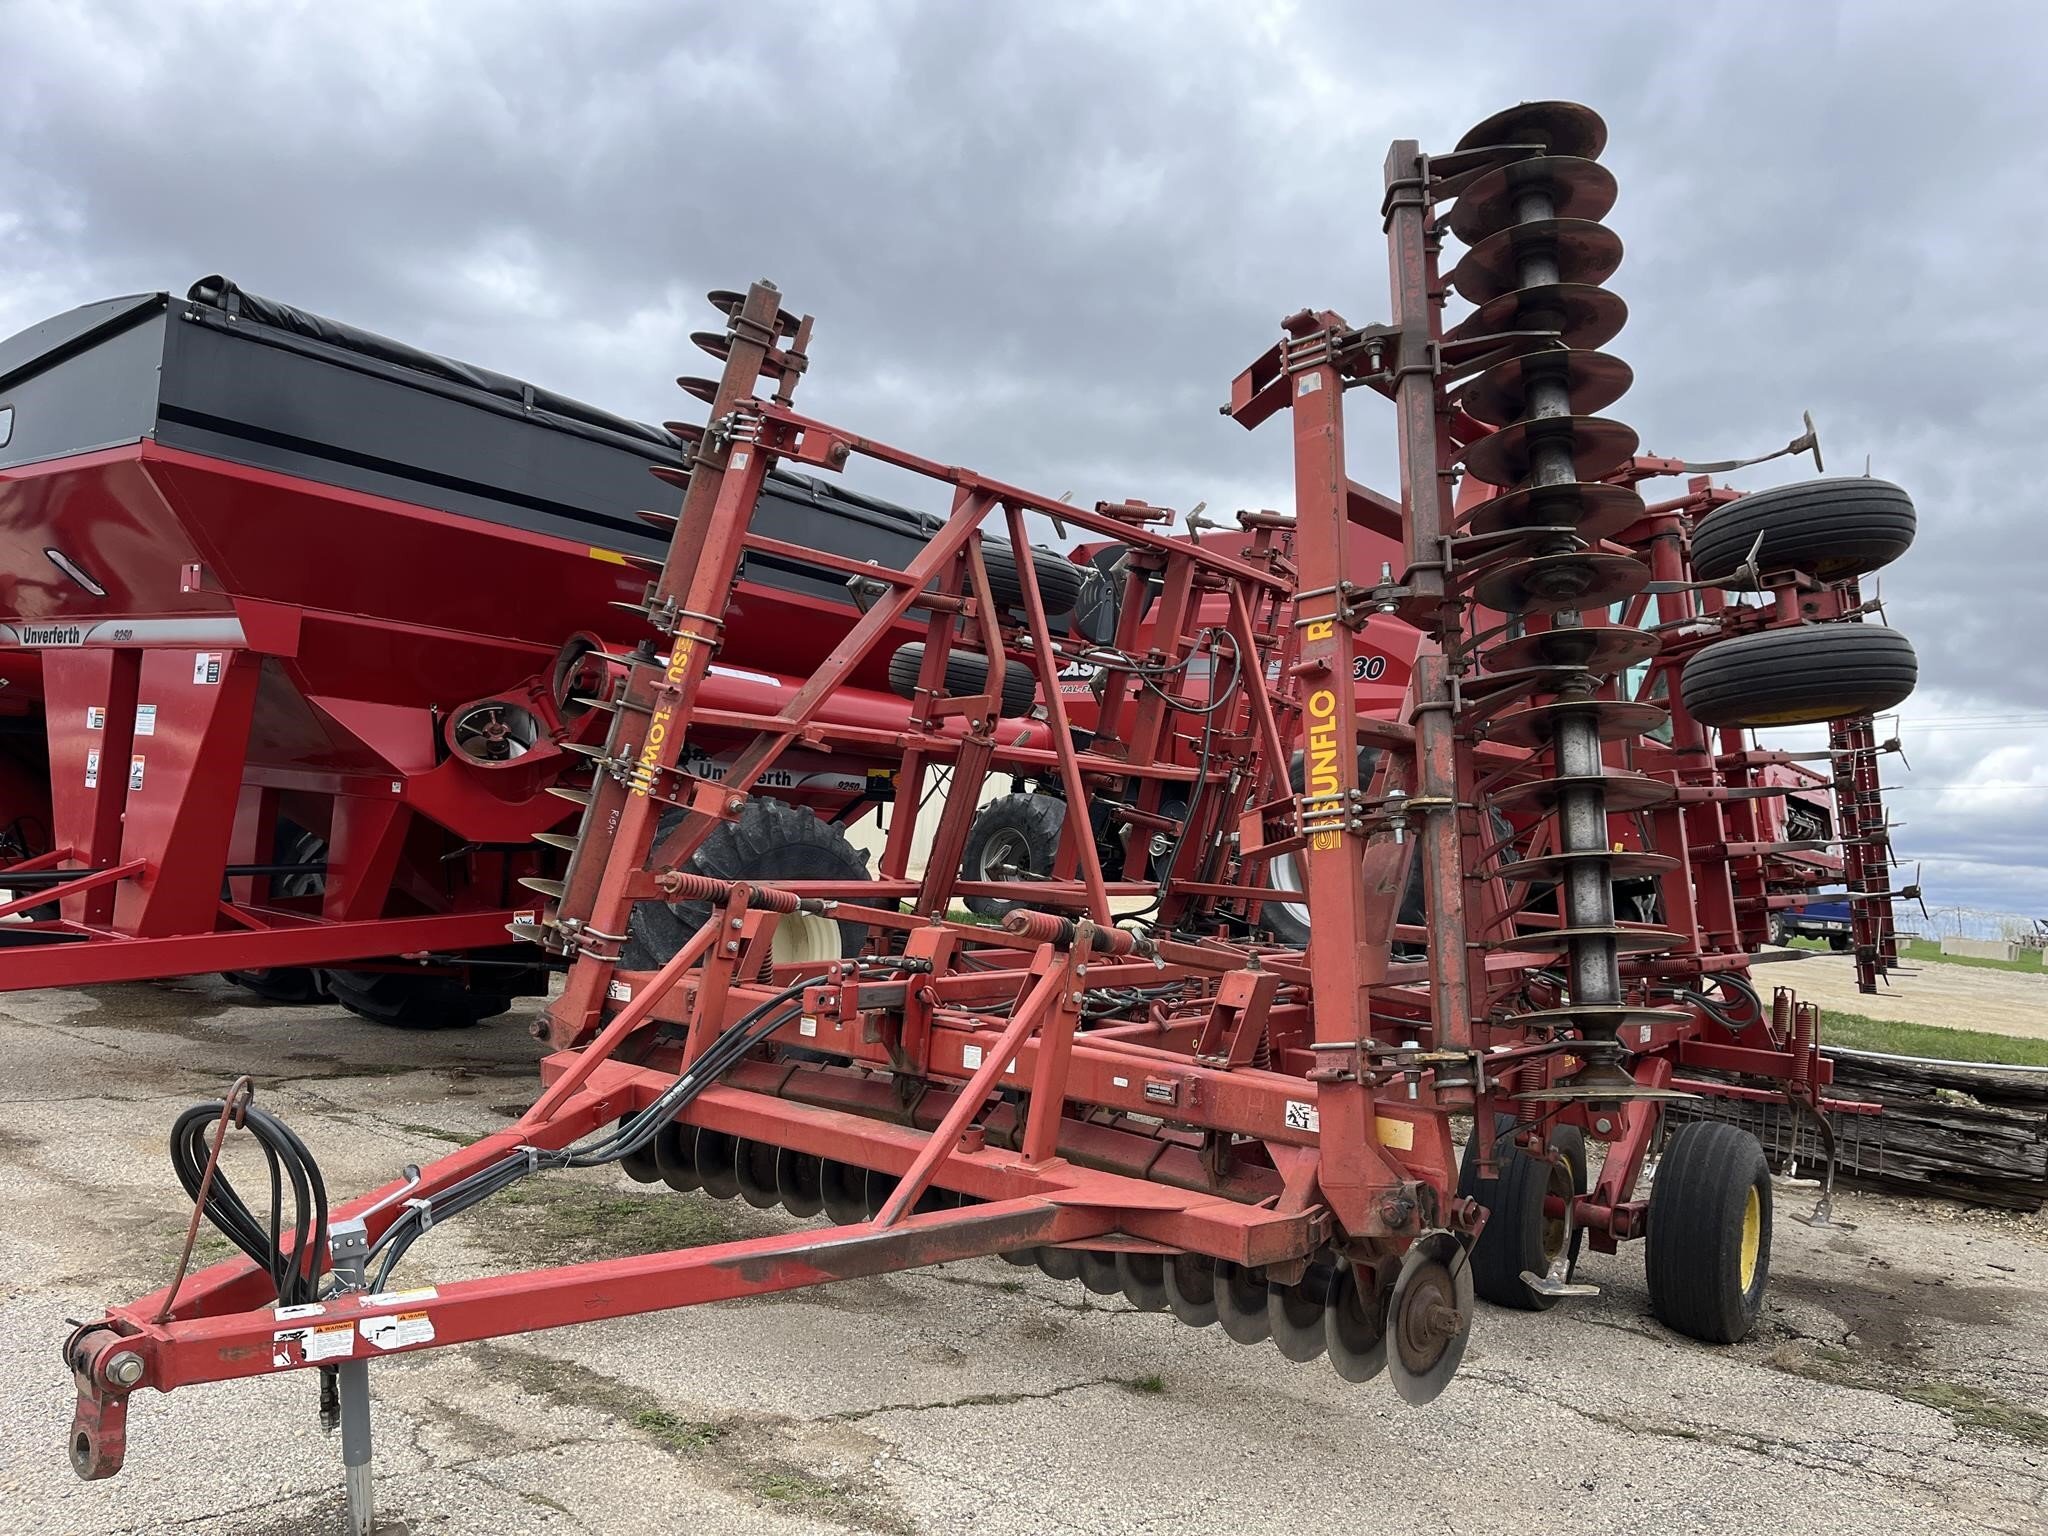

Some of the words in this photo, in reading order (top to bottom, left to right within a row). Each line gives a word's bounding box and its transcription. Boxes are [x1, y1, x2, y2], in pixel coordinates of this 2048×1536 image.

[23, 626, 80, 644] Unverferth
[1308, 620, 1340, 817] SUNFLOR
[837, 781, 859, 791] 9250
[324, 1323, 352, 1331] WARNING
